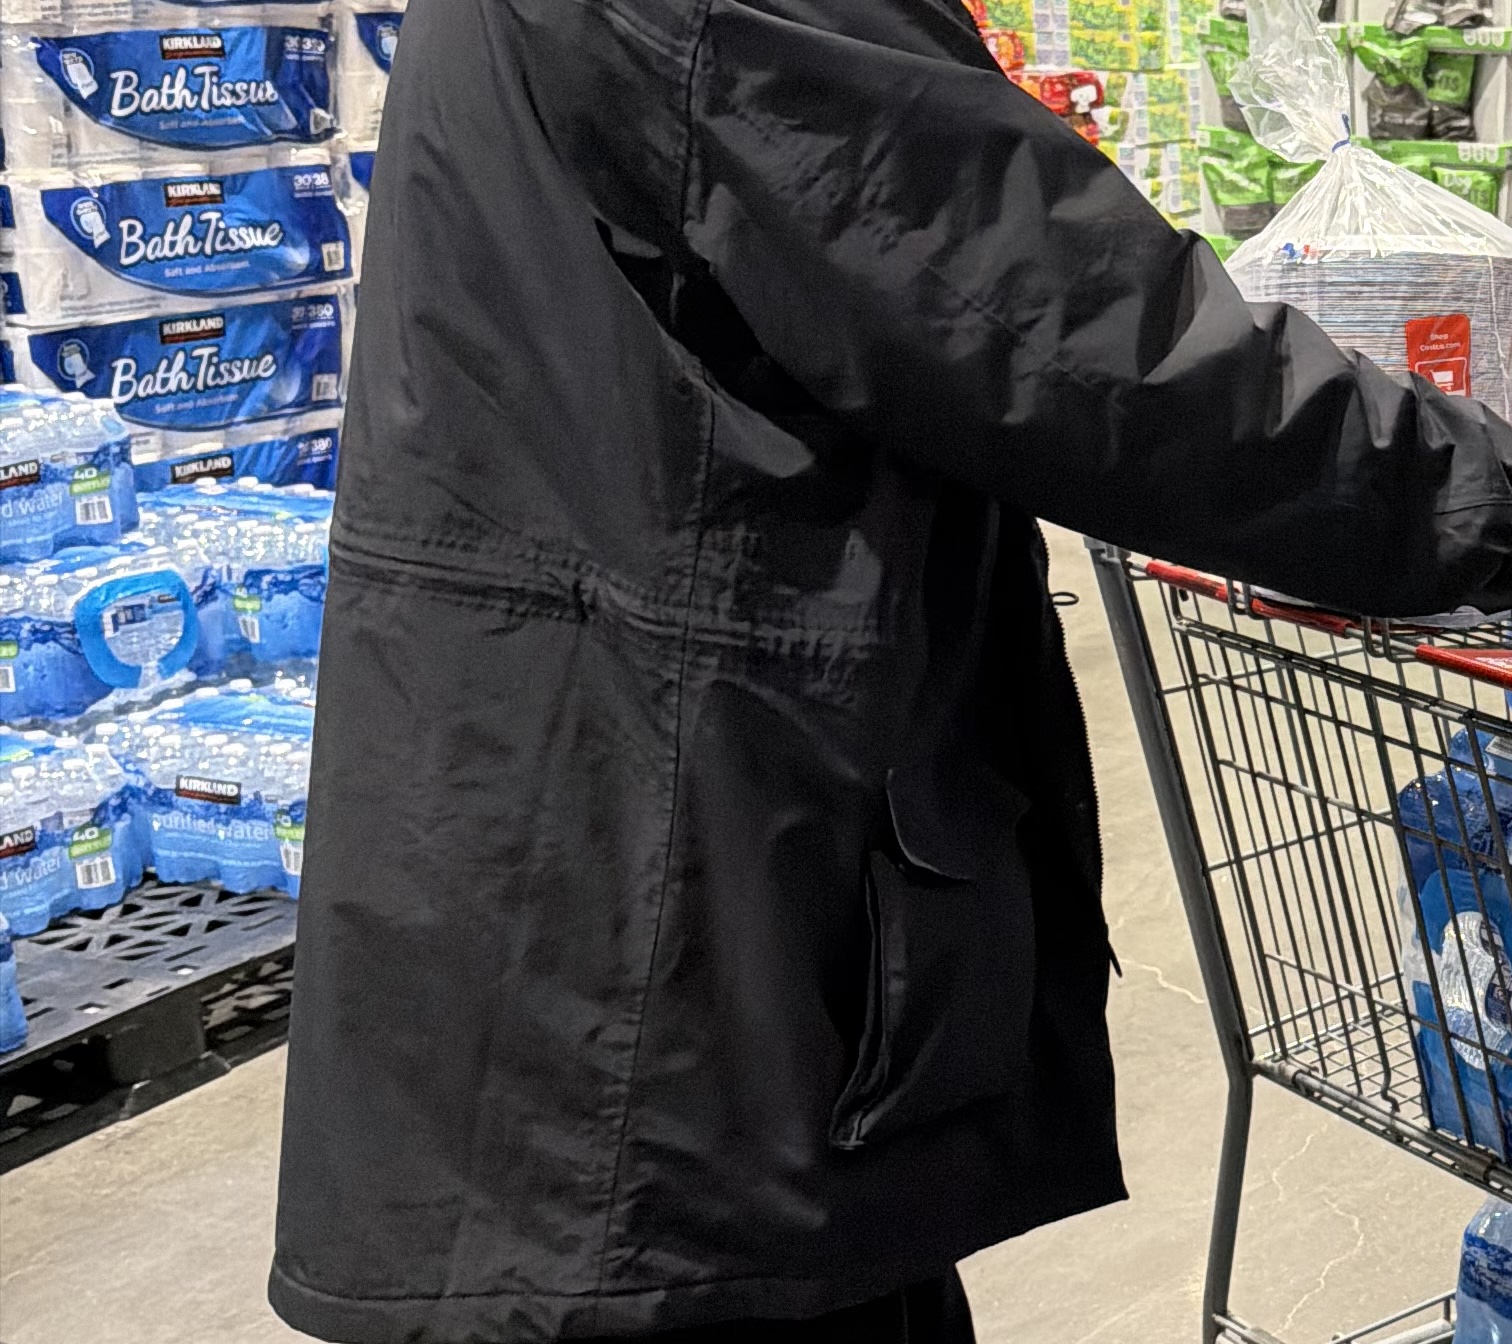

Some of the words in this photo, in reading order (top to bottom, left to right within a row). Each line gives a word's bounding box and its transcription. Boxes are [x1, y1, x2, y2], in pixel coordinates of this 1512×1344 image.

[110, 67, 198, 117] Bath
[119, 213, 203, 266] Bath
[198, 211, 283, 256] Tissue
[163, 317, 224, 335] KIRKLAND
[1420, 342, 1461, 351] Costco.com
[111, 350, 195, 404] Bath
[191, 346, 277, 391] Tissue
